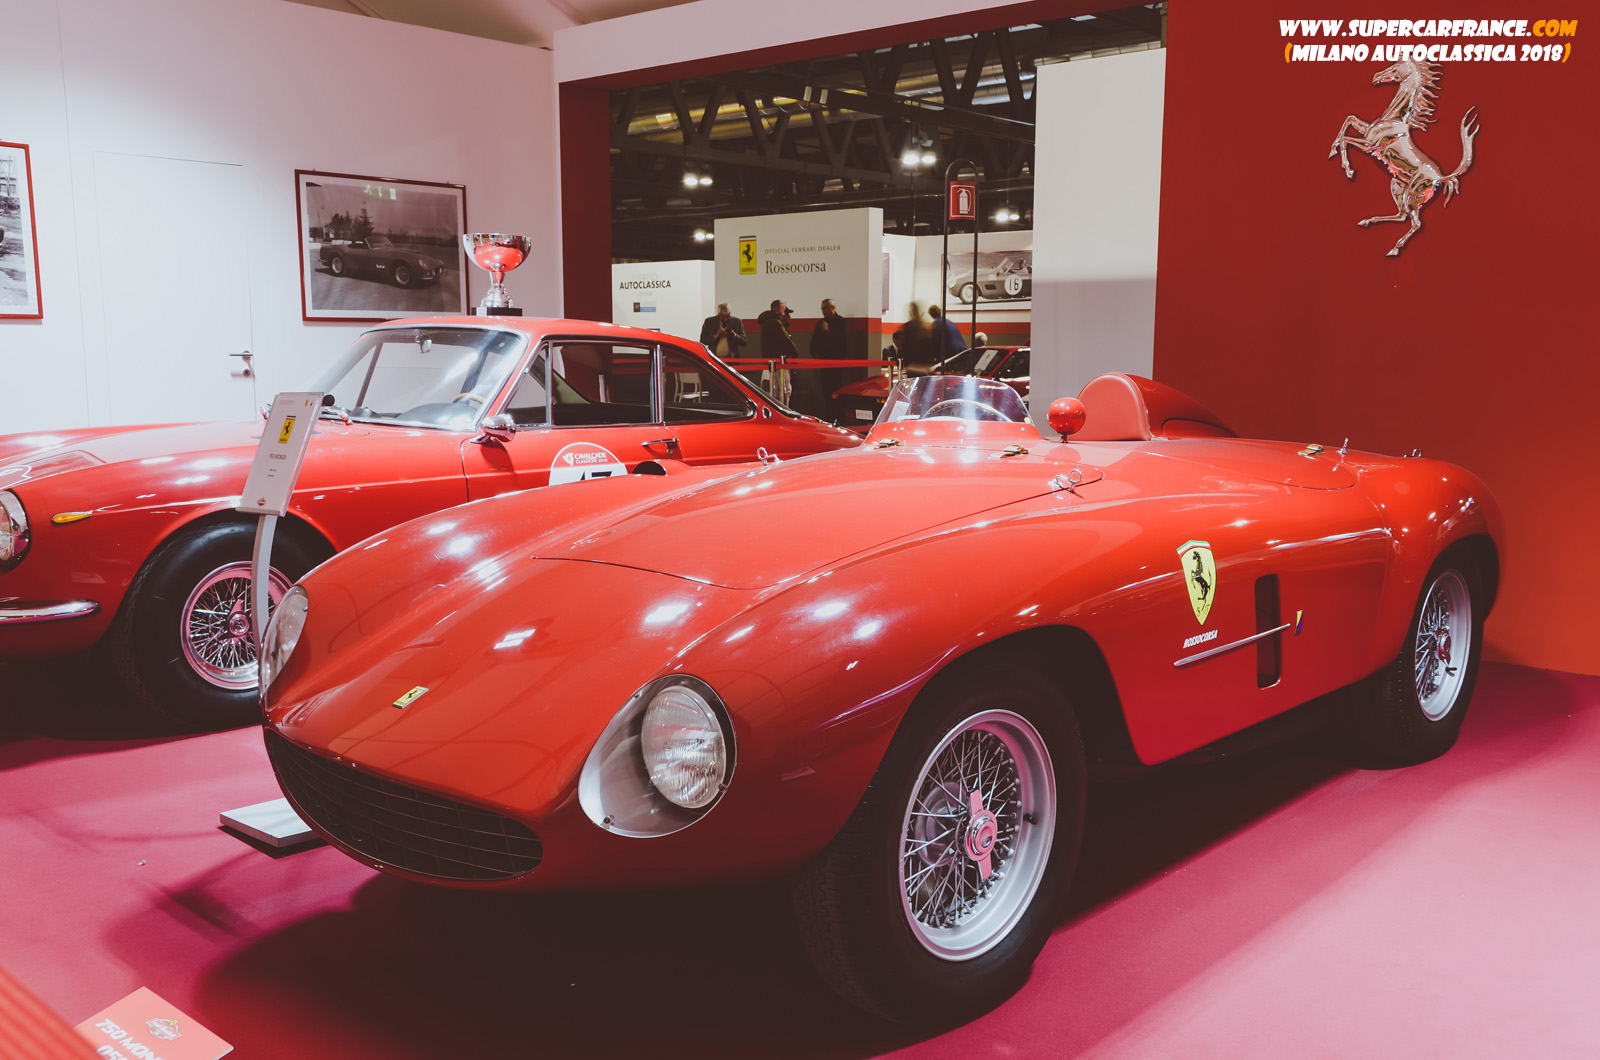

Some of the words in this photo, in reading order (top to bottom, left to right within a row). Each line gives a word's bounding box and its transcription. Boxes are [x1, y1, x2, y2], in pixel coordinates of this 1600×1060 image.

[765, 260, 826, 274] Rossocorsa
[620, 280, 671, 290] AUTOCLASSICA
[1009, 278, 1019, 291] 16
[95, 1018, 128, 1040] 750
[119, 1036, 164, 1060] MON
